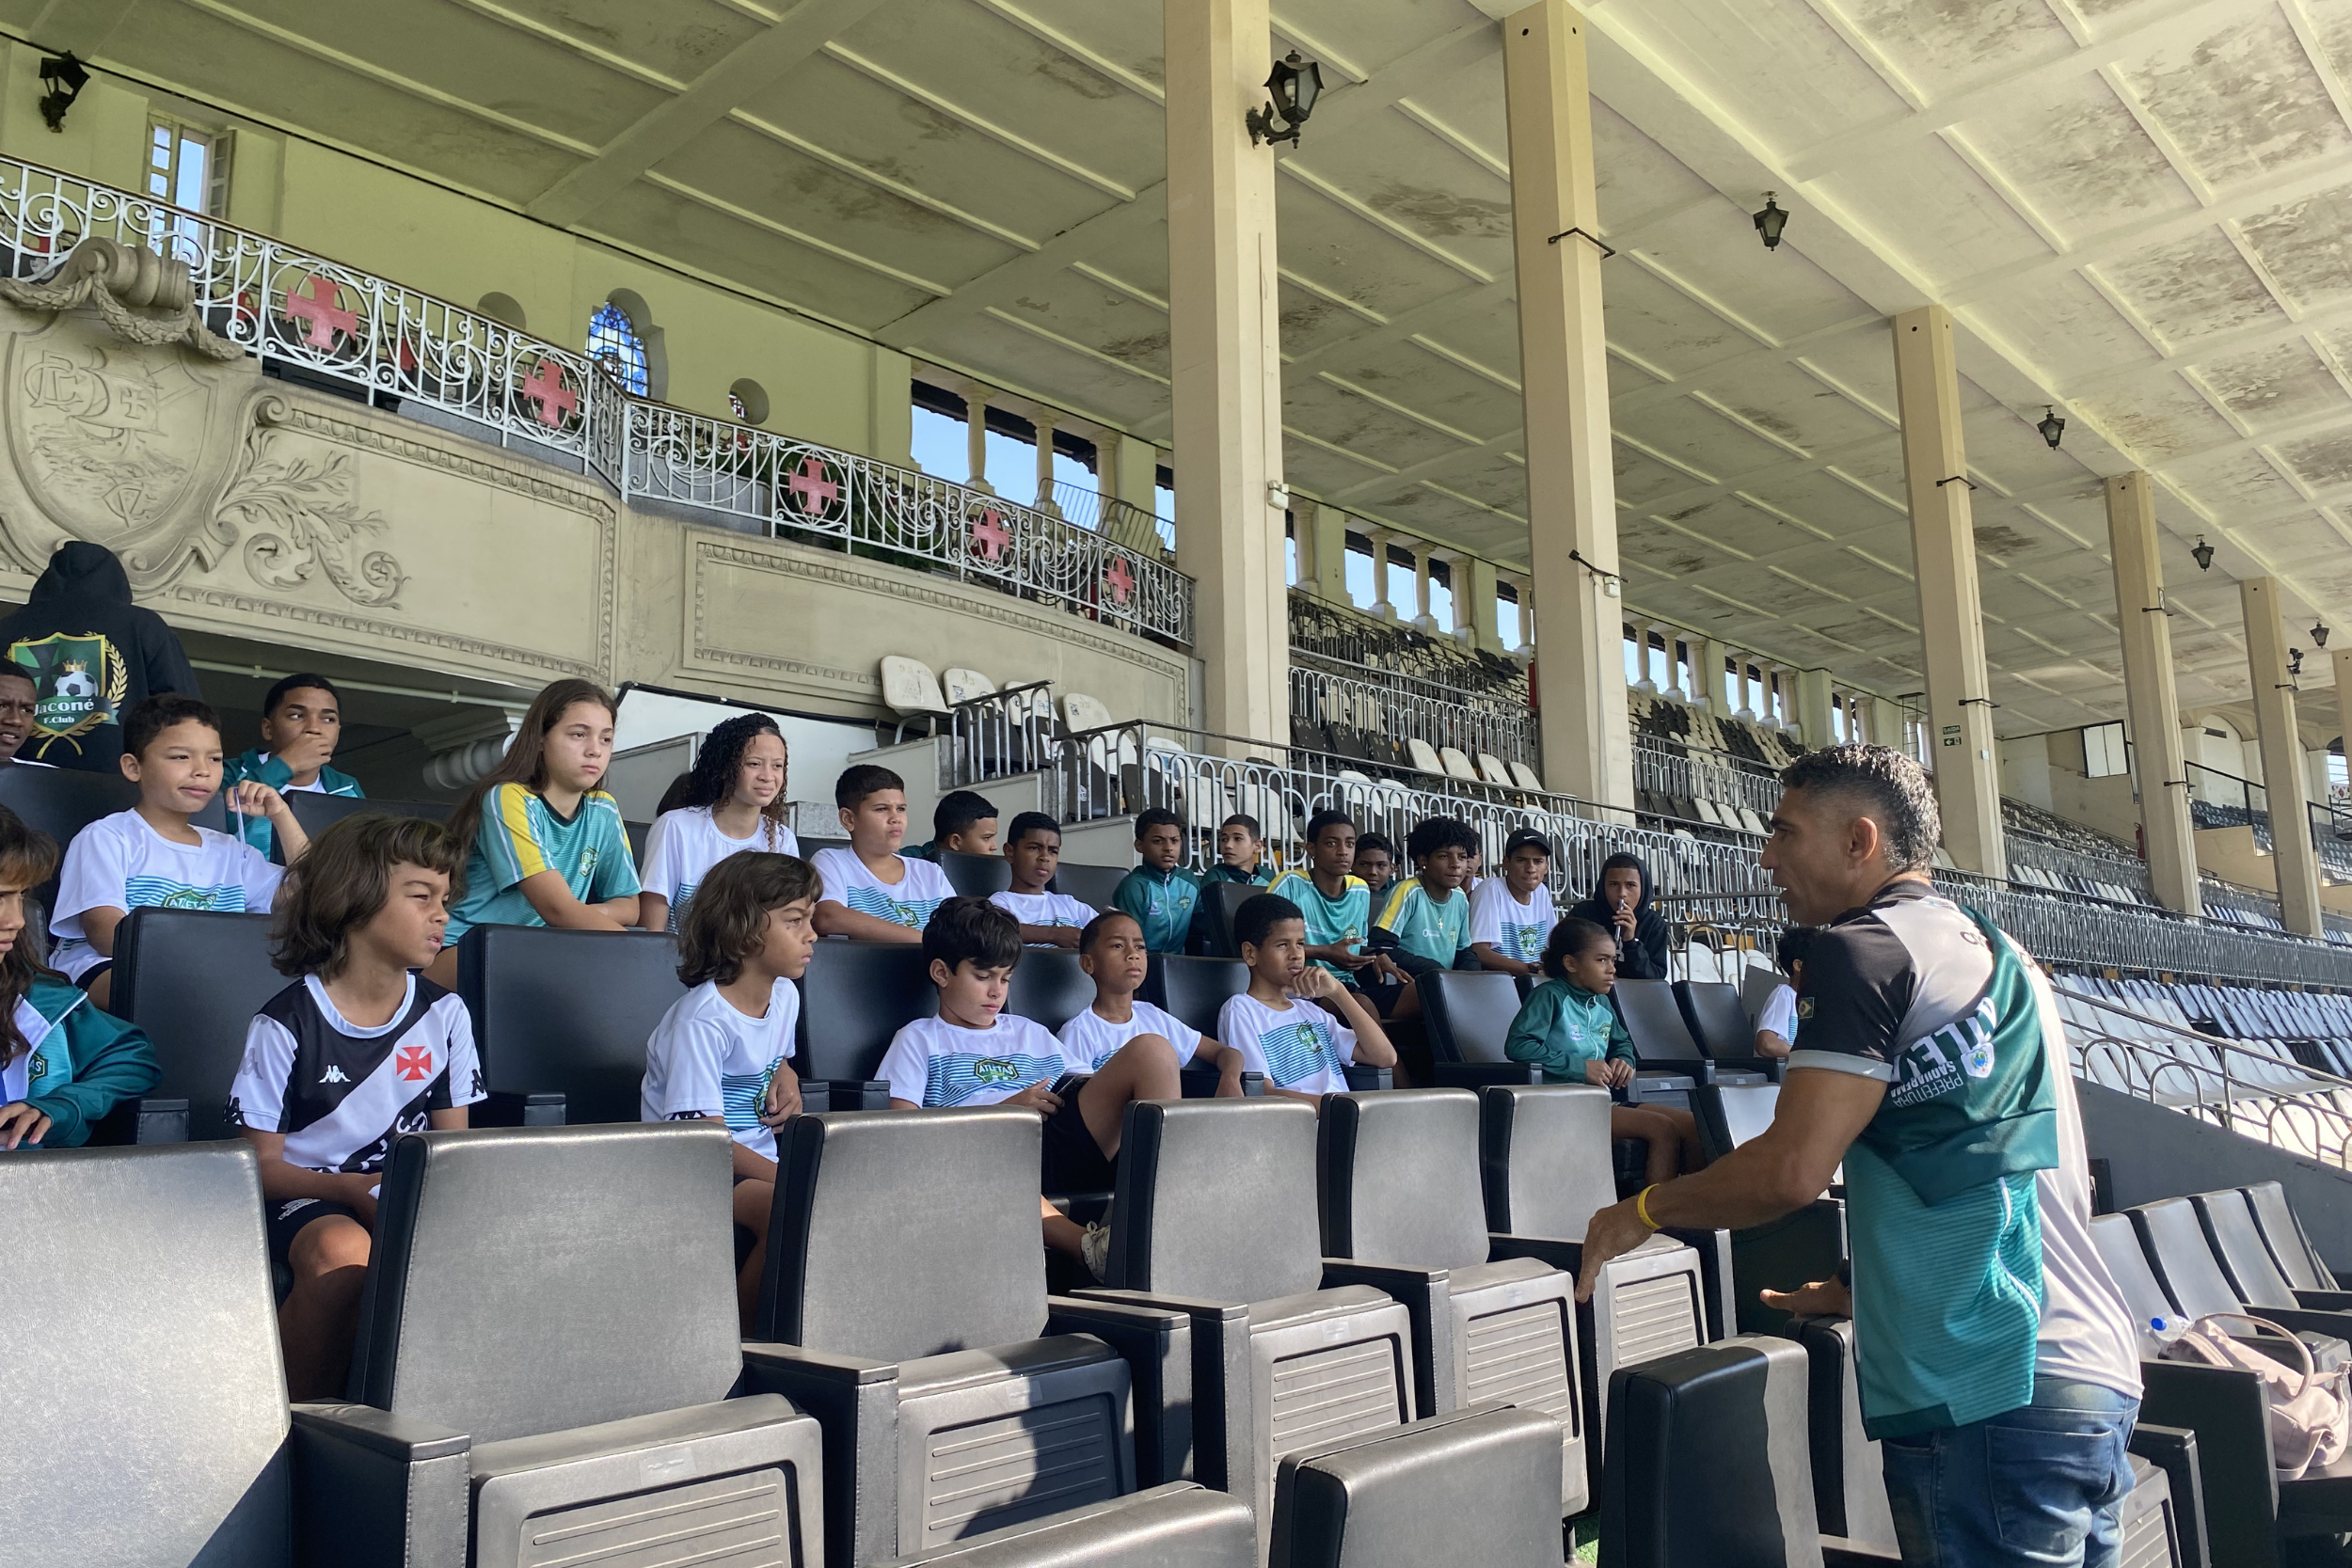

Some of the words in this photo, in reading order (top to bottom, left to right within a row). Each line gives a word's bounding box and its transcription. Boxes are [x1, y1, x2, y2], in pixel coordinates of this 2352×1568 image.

[33, 698, 94, 717] Jaconé
[978, 1063, 1014, 1075] ATLETAS
[1893, 1072, 1964, 1108] PREFEITURA
